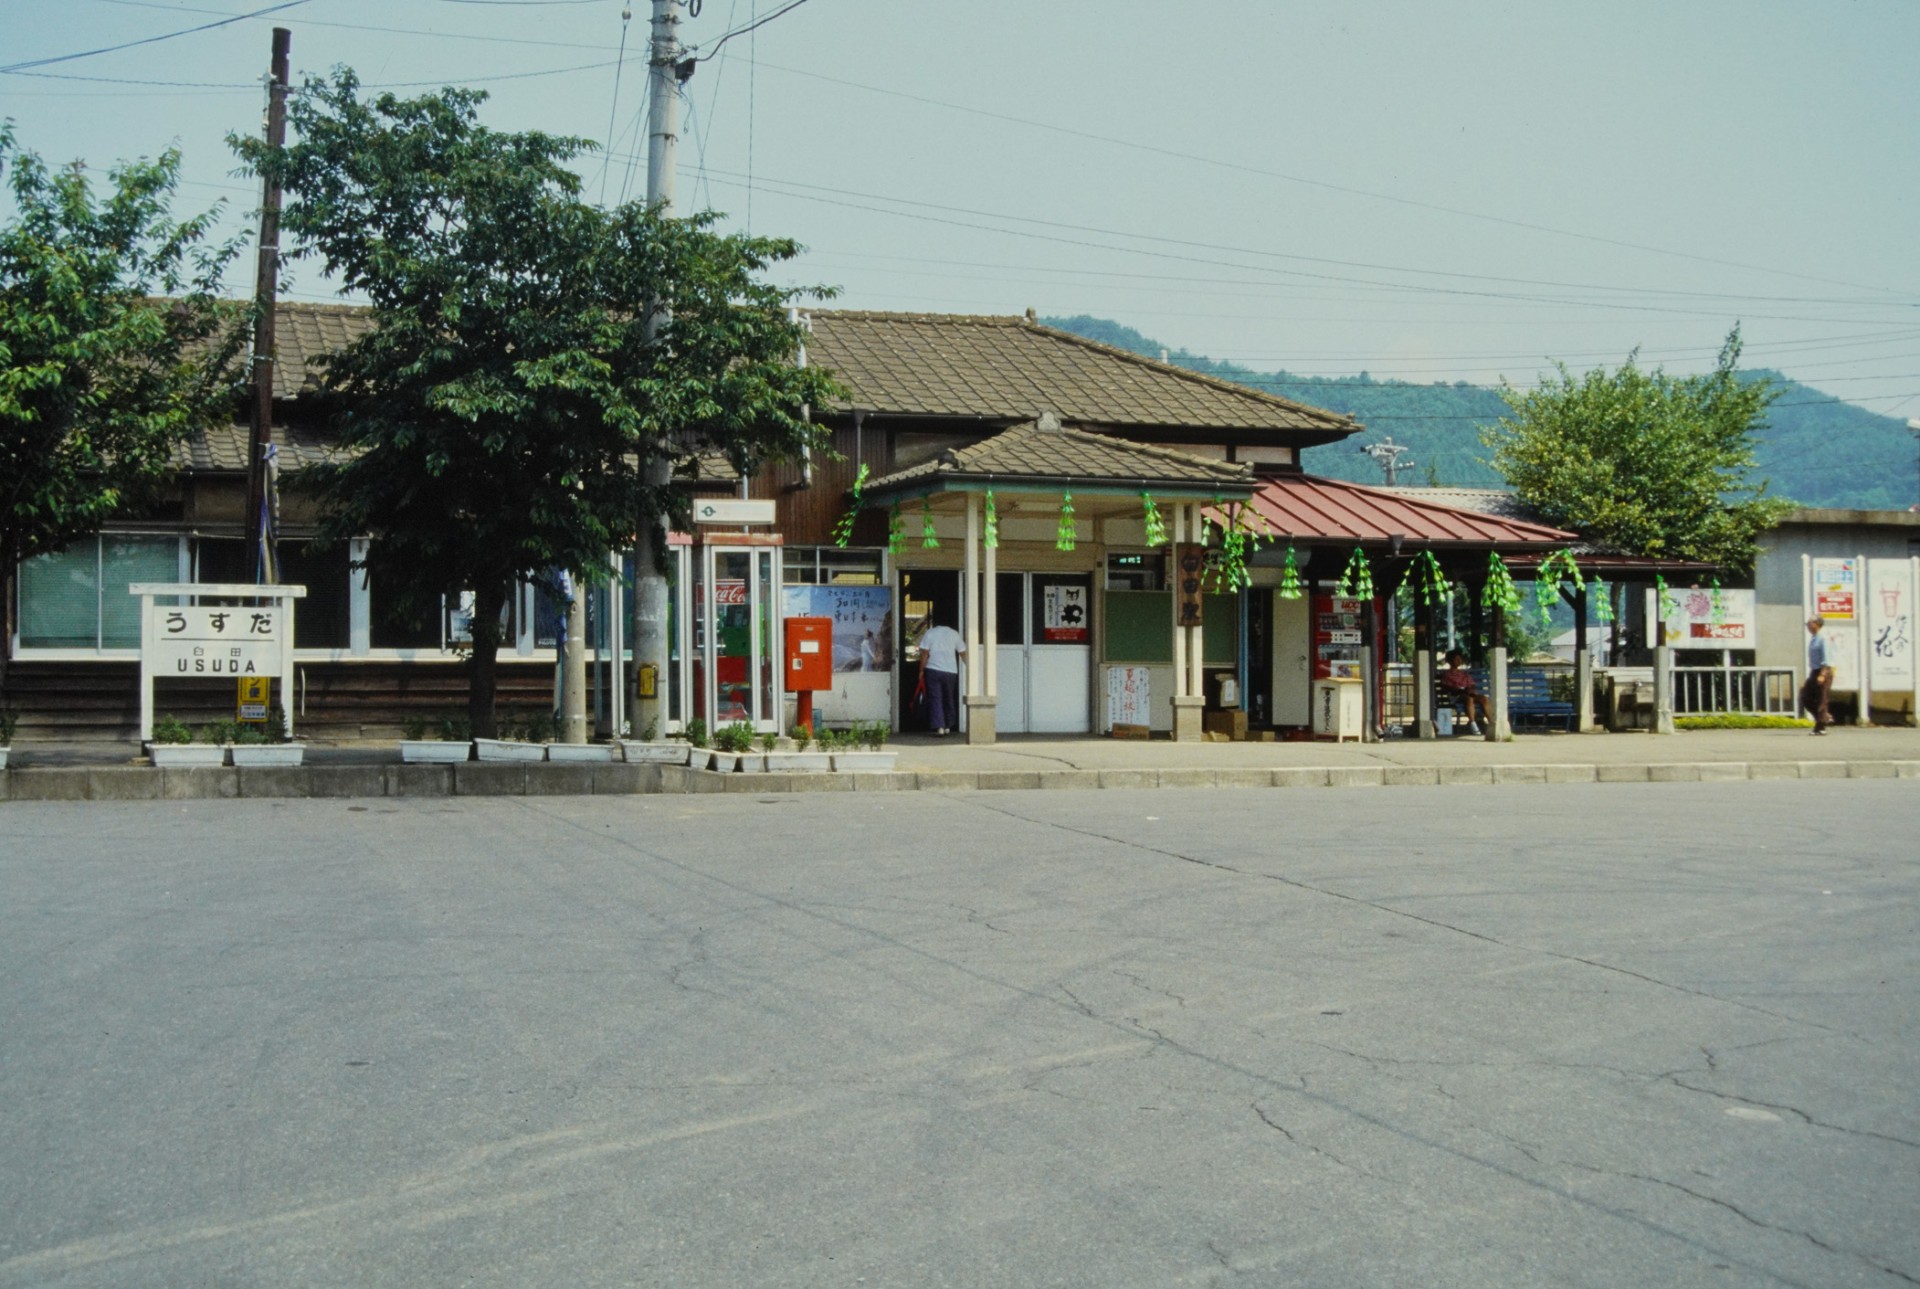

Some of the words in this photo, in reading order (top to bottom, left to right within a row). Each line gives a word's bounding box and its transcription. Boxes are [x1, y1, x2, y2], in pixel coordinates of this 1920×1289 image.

[166, 612, 272, 634] うすだ
[193, 647, 241, 657] 臼田
[177, 658, 256, 673] USUDA
